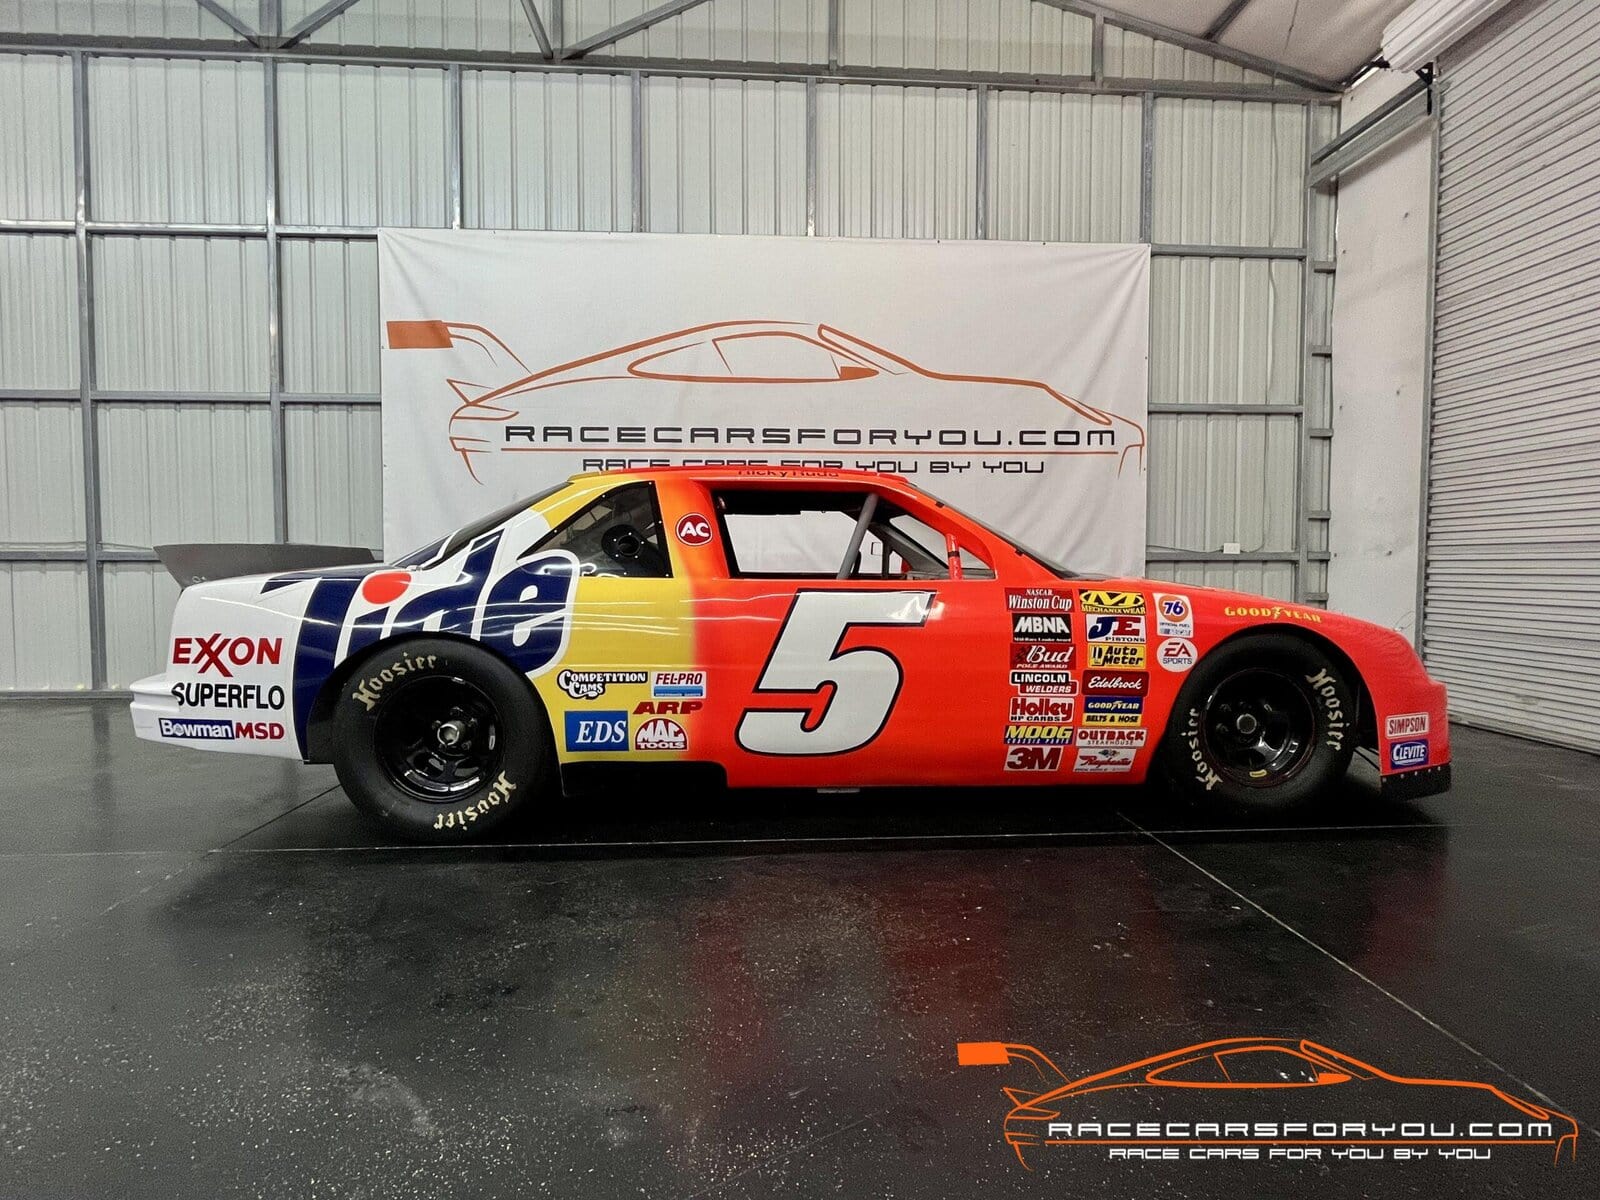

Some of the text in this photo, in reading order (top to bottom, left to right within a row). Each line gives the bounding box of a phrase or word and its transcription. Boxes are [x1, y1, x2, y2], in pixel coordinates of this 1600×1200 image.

[505, 425, 1115, 446] RACECARSFORYOU.COM
[856, 461, 918, 474] YOU
[930, 461, 971, 474] BY
[983, 461, 1045, 474] YOU
[680, 521, 710, 538] AC
[1025, 588, 1055, 596] NASCAR
[1008, 594, 1073, 611] Winston Cup
[1081, 603, 1122, 614] MECHANIX
[1163, 601, 1184, 615] 76
[1224, 606, 1322, 623] GOODYEAR
[1014, 616, 1071, 634] MBNA
[1088, 616, 1142, 639] JE
[172, 633, 283, 678] EXXON
[1026, 645, 1075, 664] Bud
[1105, 646, 1139, 656] Auto
[1163, 642, 1192, 658] EA
[1102, 655, 1145, 667] Meter
[1163, 657, 1193, 665] SPORTS
[735, 588, 937, 757] 5
[1014, 673, 1066, 683] LINCOLN
[352, 652, 438, 712] Hoosier
[1025, 685, 1072, 693] WELDERS
[1088, 675, 1143, 690] Edelbrock
[171, 682, 286, 710] SUPERFLO
[632, 701, 704, 715] ARP
[1011, 698, 1074, 722] Holley
[1087, 700, 1140, 711] GOODYEAR
[1305, 668, 1350, 751] Hoosier
[1118, 715, 1139, 723] HOSE
[1389, 716, 1426, 735] SIMPSON
[160, 718, 285, 740] Bowman MSD
[575, 720, 627, 744] EDS
[636, 720, 685, 743] MAC
[1005, 725, 1075, 739] MOOG
[1078, 730, 1145, 741] OUTBACK
[1181, 708, 1223, 790] Hoosier
[1392, 744, 1426, 762] CLEVITE
[1007, 747, 1062, 770] 3M
[433, 770, 517, 830] Hoosier
